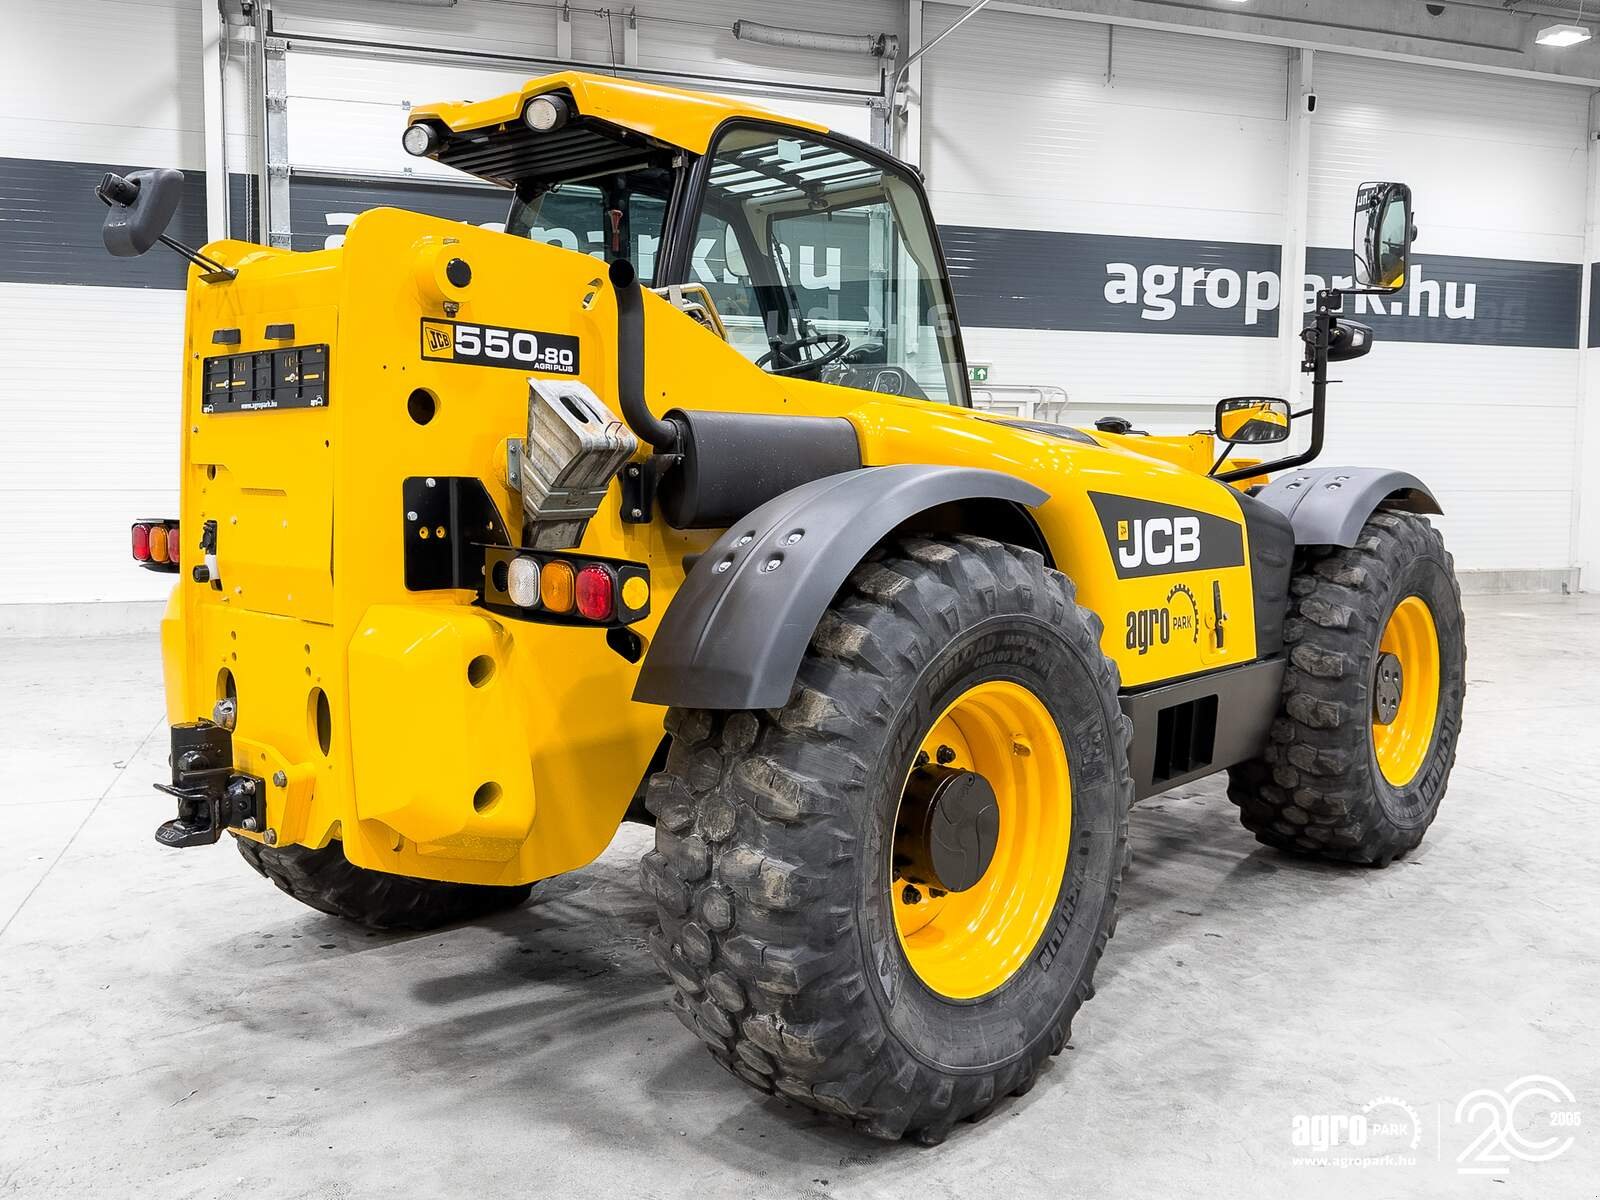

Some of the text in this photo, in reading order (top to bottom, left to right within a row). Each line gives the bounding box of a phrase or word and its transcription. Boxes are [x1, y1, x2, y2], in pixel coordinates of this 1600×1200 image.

[430, 330, 450, 349] JCB
[534, 362, 574, 373] AGRI PLUS
[1118, 516, 1200, 569] JCB
[1126, 607, 1192, 656] agro PARK
